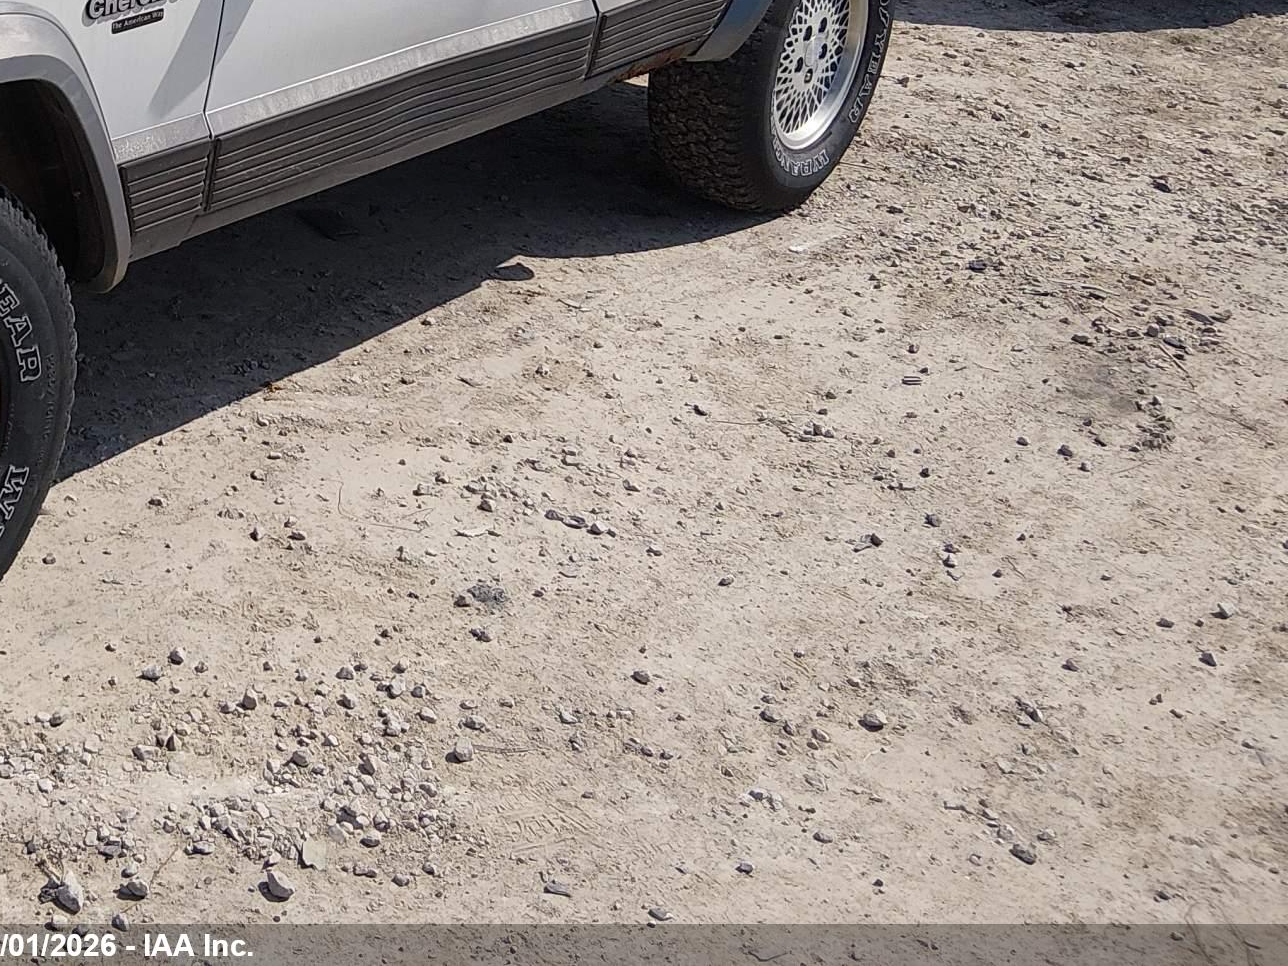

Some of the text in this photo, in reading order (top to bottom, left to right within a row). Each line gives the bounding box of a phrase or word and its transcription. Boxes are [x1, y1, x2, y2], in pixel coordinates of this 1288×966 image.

[113, 10, 164, 30] The American Way
